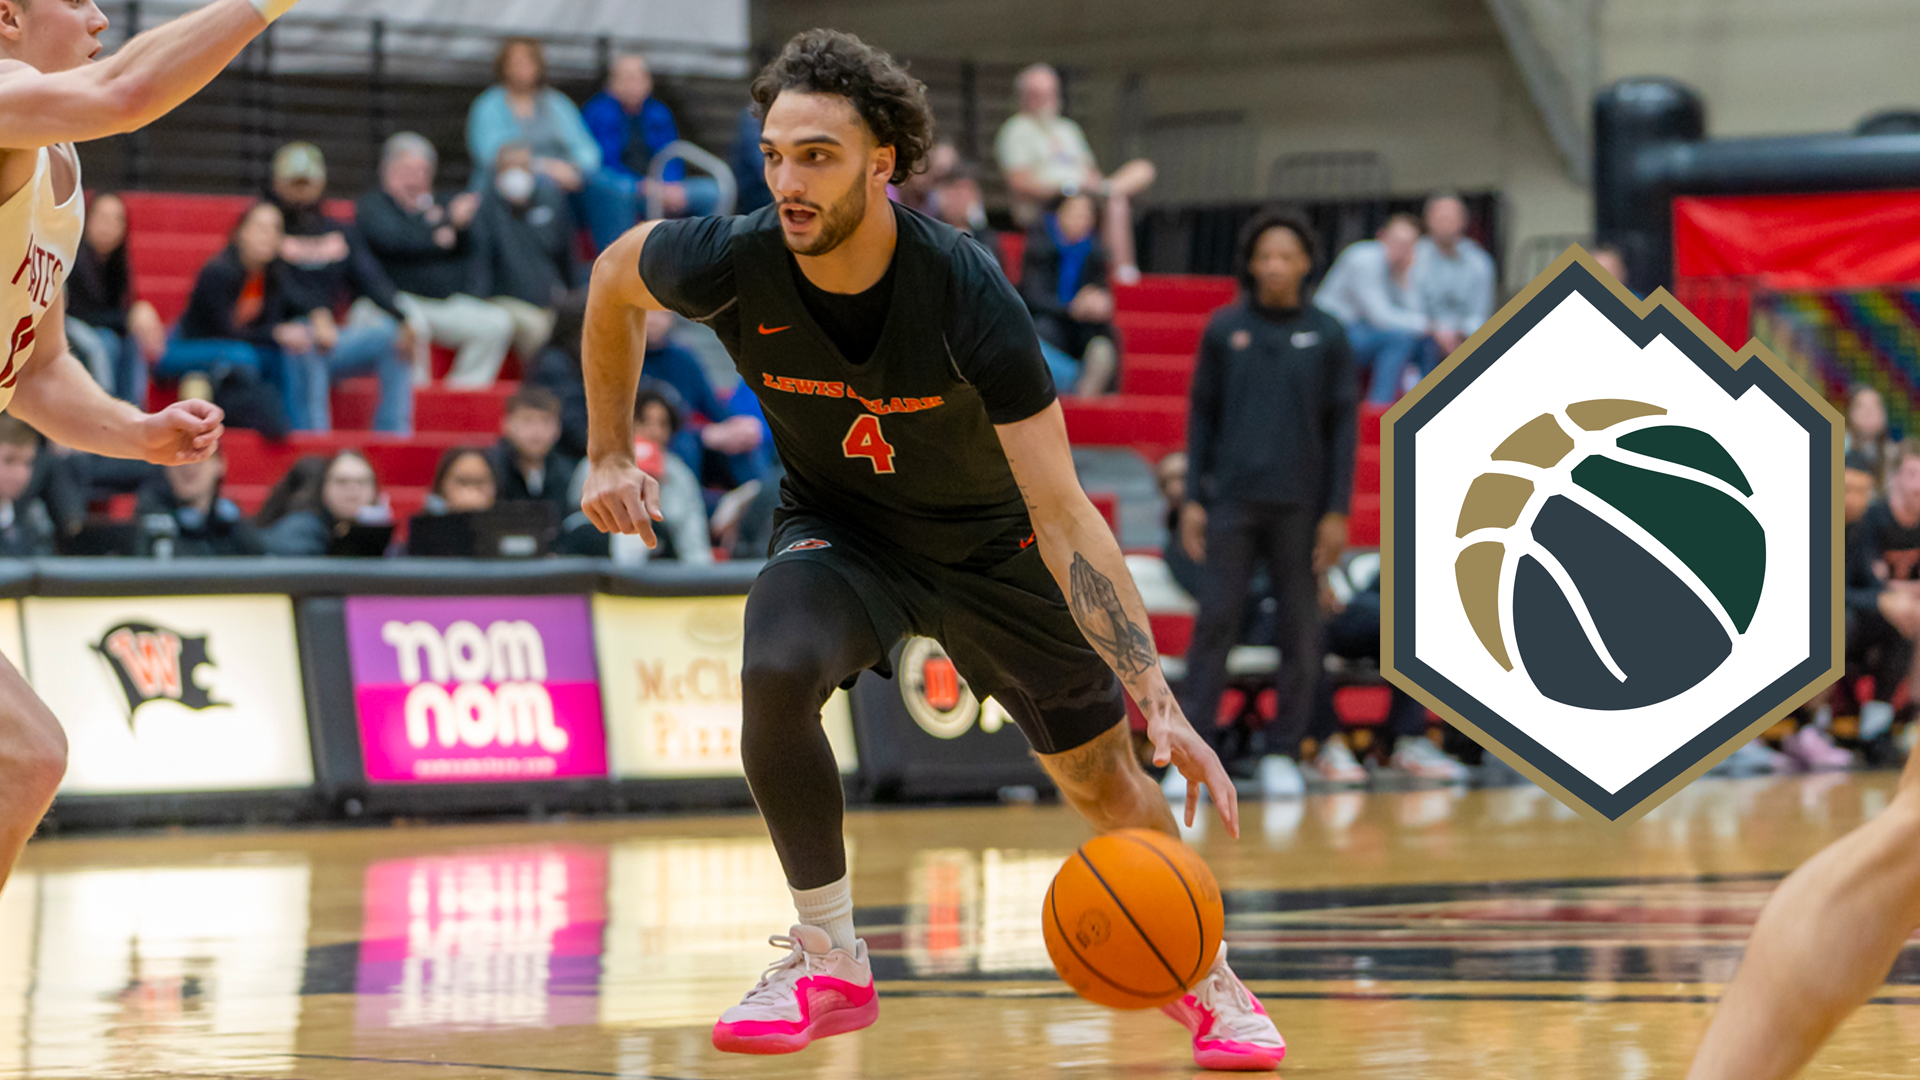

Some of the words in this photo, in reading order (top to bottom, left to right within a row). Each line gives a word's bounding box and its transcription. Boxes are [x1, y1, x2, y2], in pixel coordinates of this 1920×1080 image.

[762, 372, 844, 398] LEWIS
[842, 414, 895, 474] 4
[106, 626, 183, 700] W
[382, 619, 548, 685] nom
[404, 681, 568, 753] nom
